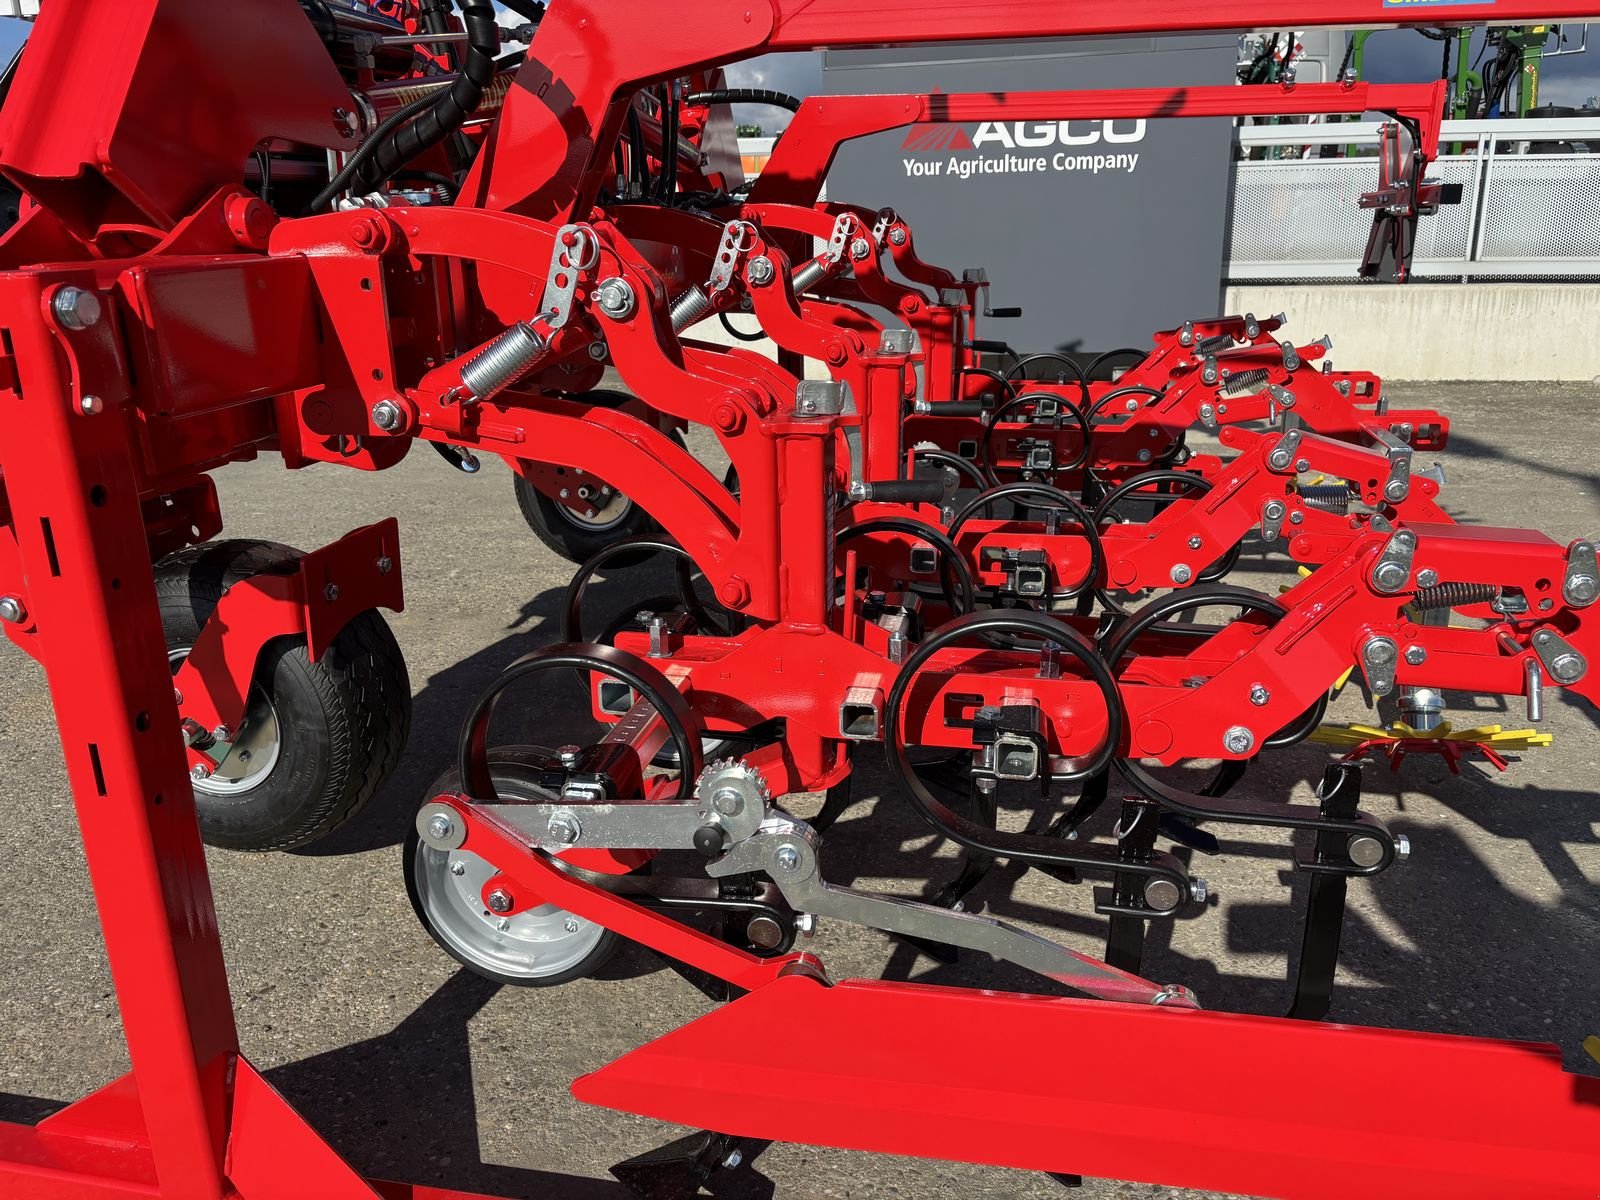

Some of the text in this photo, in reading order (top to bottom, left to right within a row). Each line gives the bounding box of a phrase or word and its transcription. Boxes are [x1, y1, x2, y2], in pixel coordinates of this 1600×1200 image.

[972, 118, 1147, 149] AGCO
[903, 152, 1139, 179] Your Agriculture Company
